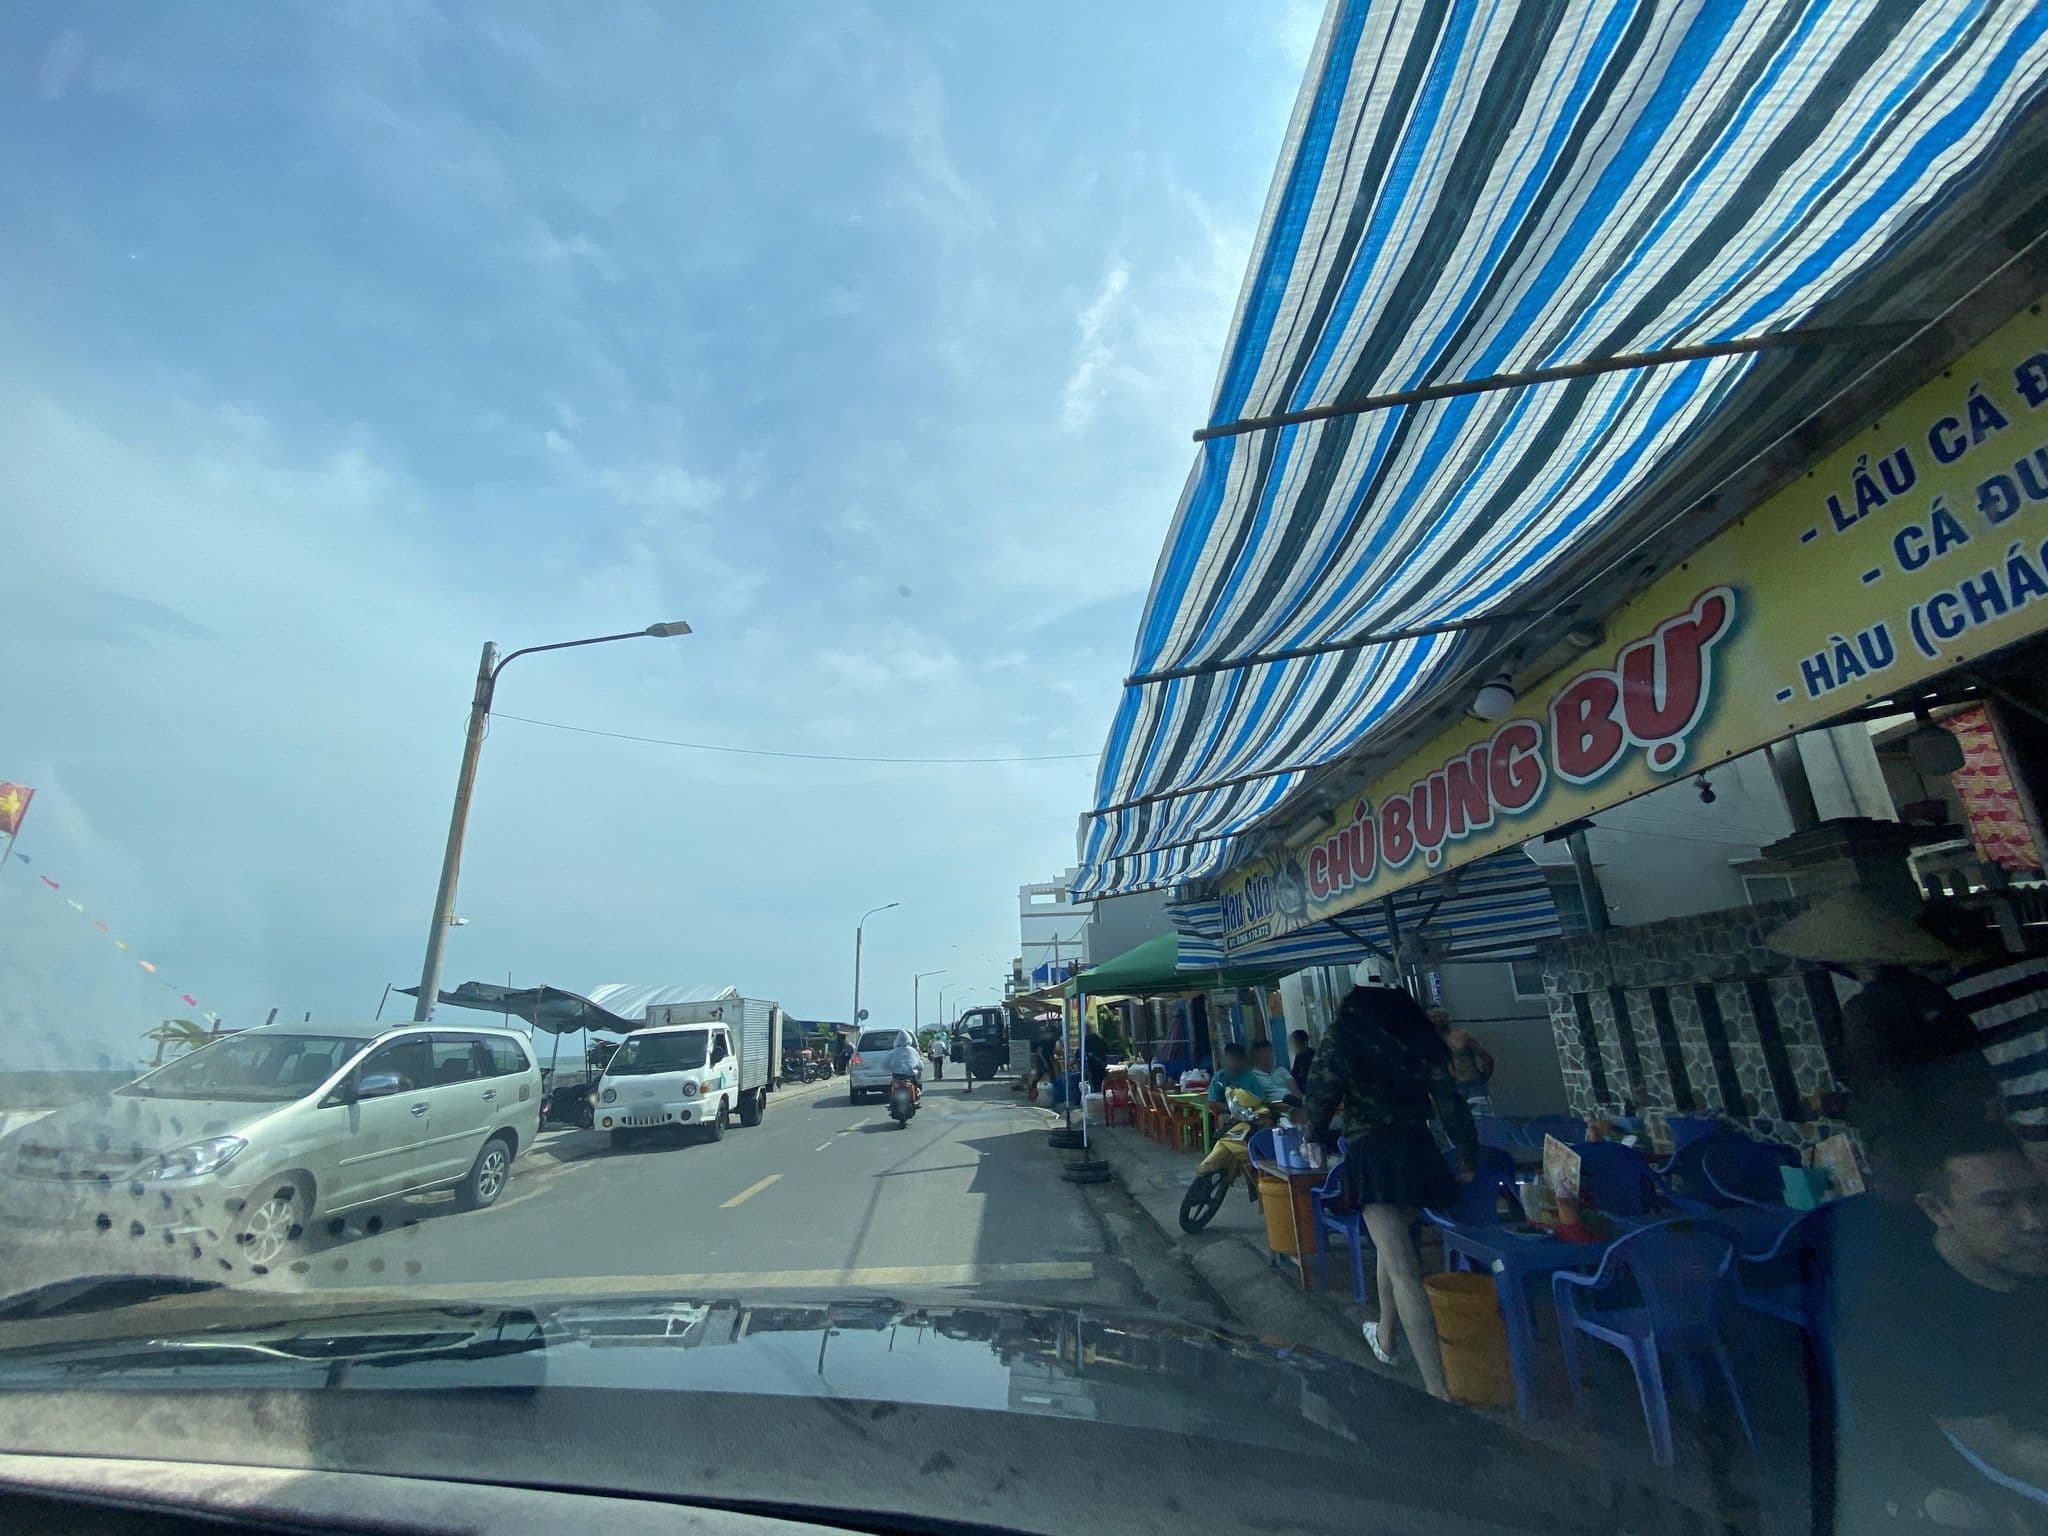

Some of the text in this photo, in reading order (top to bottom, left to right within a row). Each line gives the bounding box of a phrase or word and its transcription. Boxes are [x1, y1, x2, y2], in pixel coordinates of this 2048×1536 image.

[1826, 447, 1917, 533] LẨU
[1926, 383, 2010, 464] CÁ
[1892, 495, 1971, 571] CÁ
[1799, 623, 1895, 697] HÀU
[1910, 542, 2048, 658] (CHÁ
[1307, 587, 1735, 902] CHÚ BỤNG BỰ
